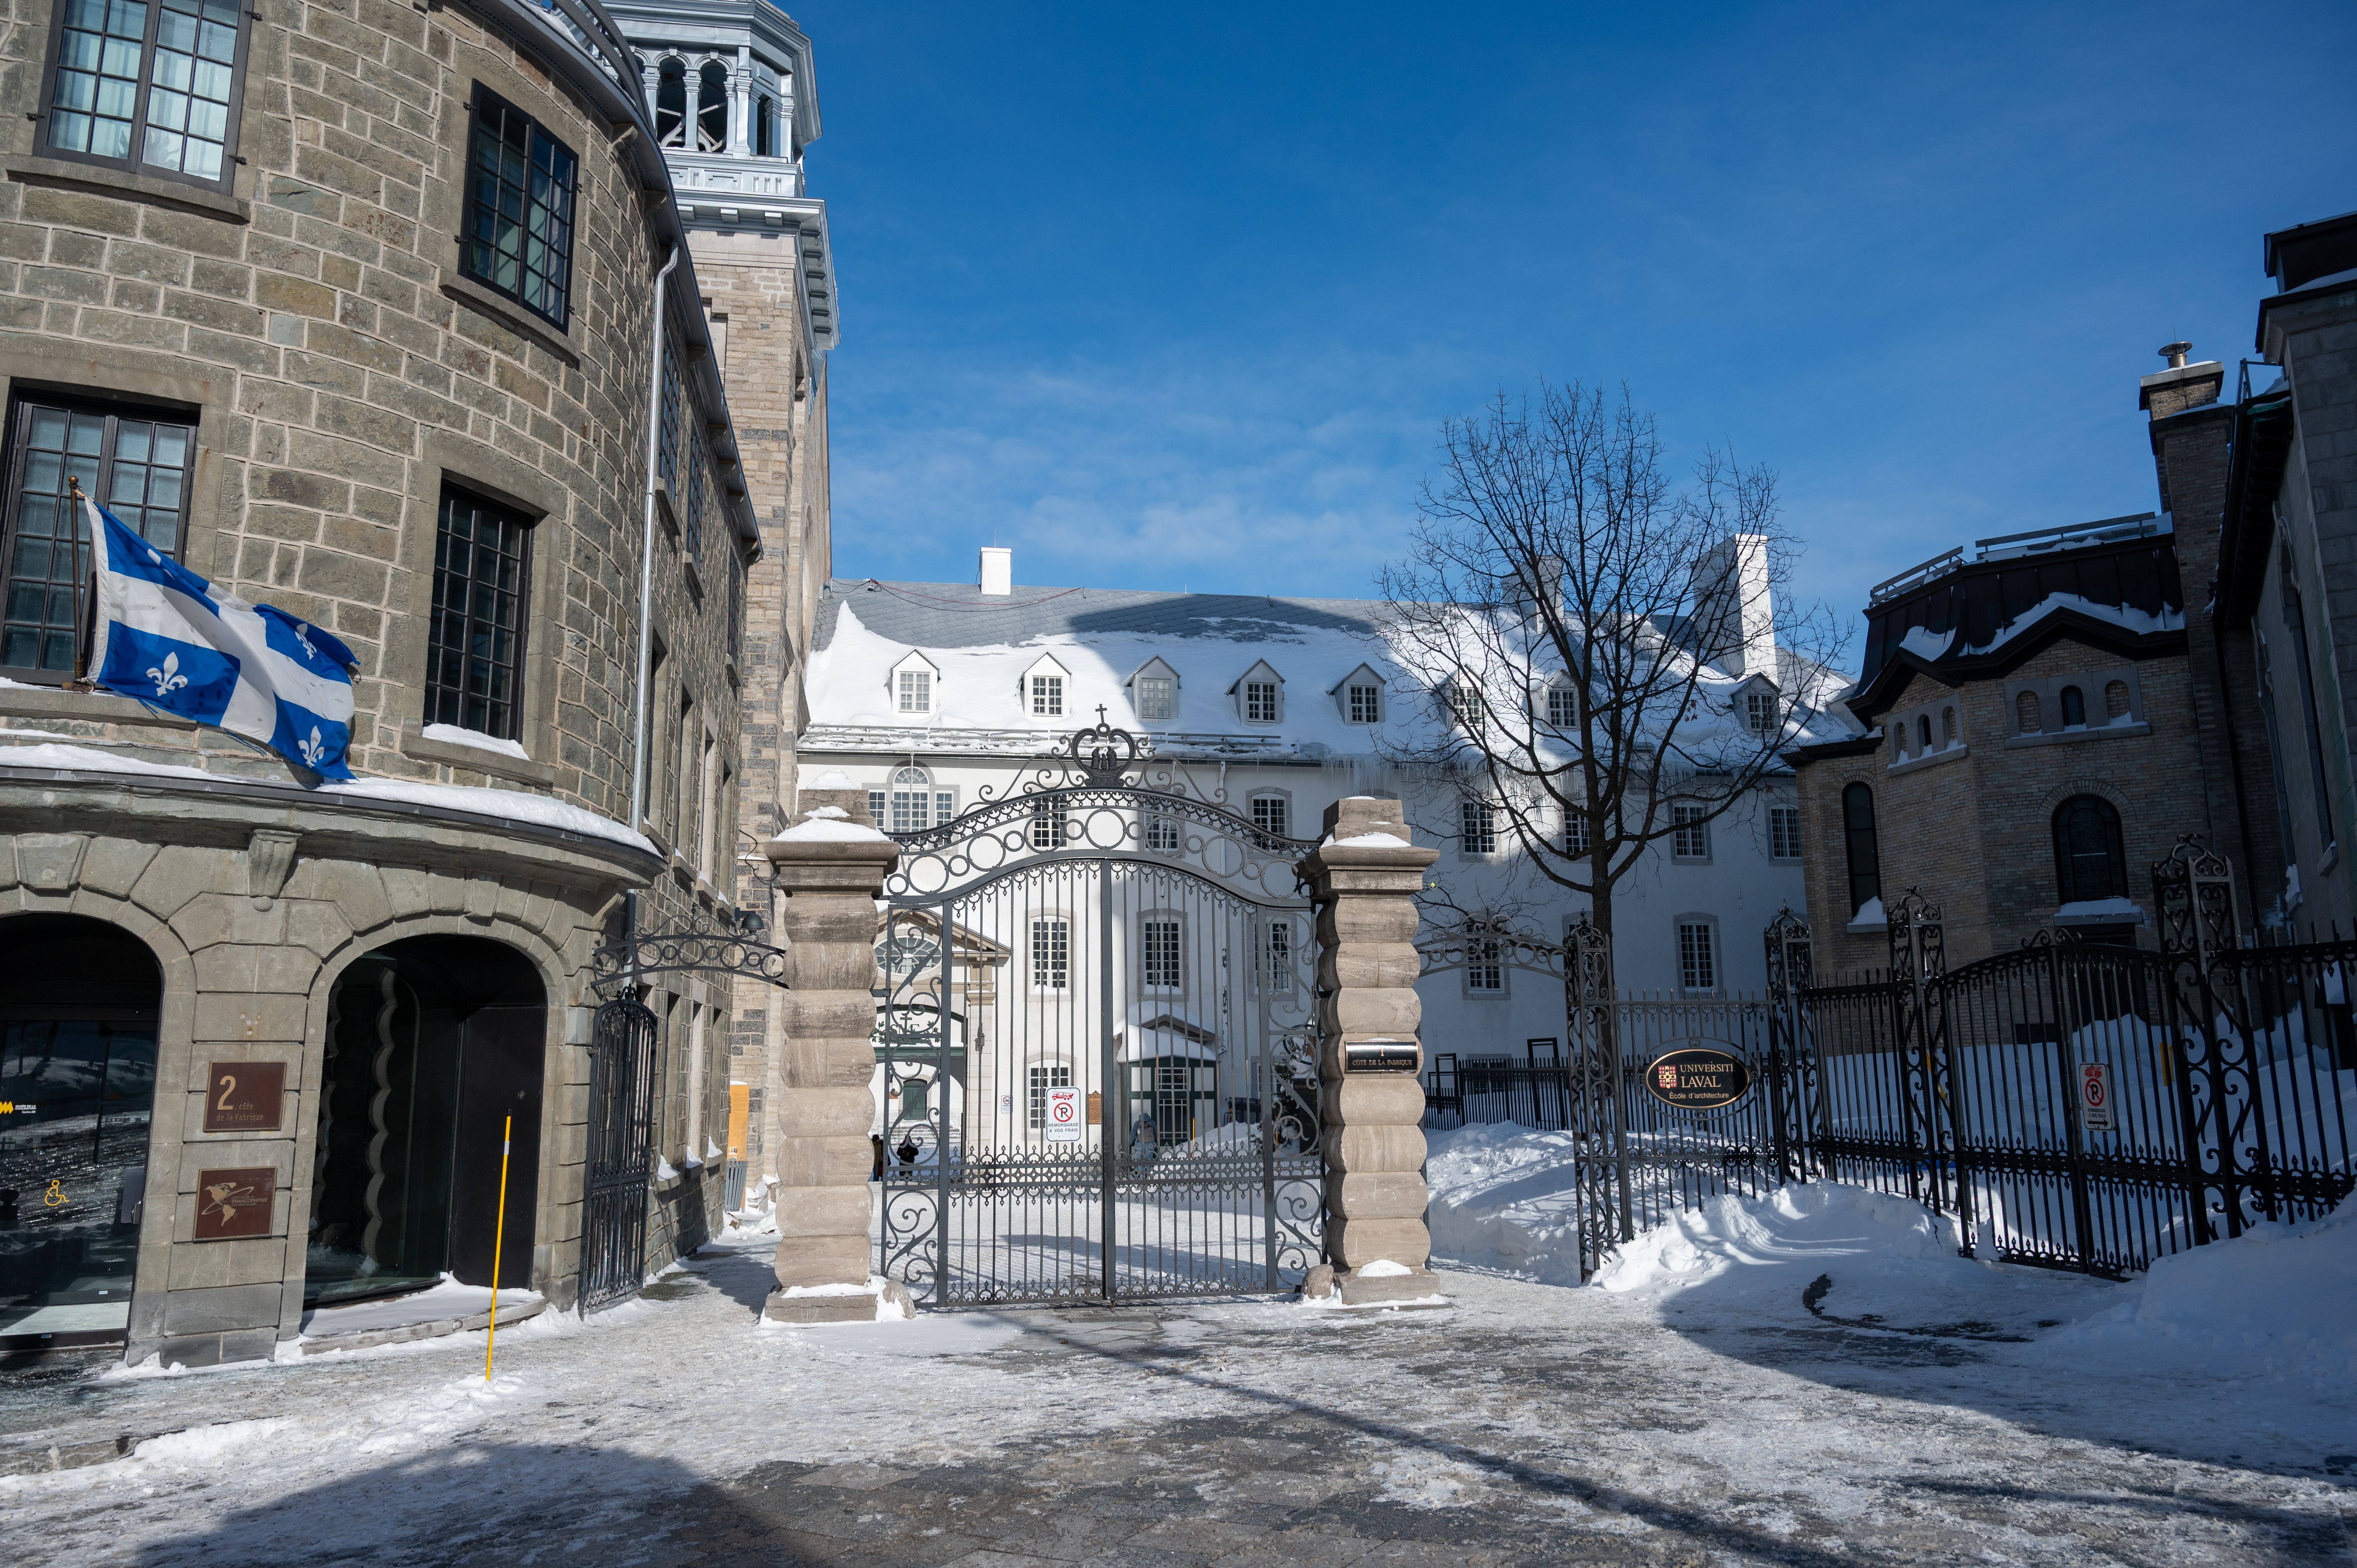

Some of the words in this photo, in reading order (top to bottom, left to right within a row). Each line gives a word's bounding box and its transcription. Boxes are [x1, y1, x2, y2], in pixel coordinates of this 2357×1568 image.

[1679, 1062, 1736, 1072] UNIVERSITÉ
[1680, 1075, 1721, 1088] LAVAL
[235, 1114, 264, 1122] Fabrique
